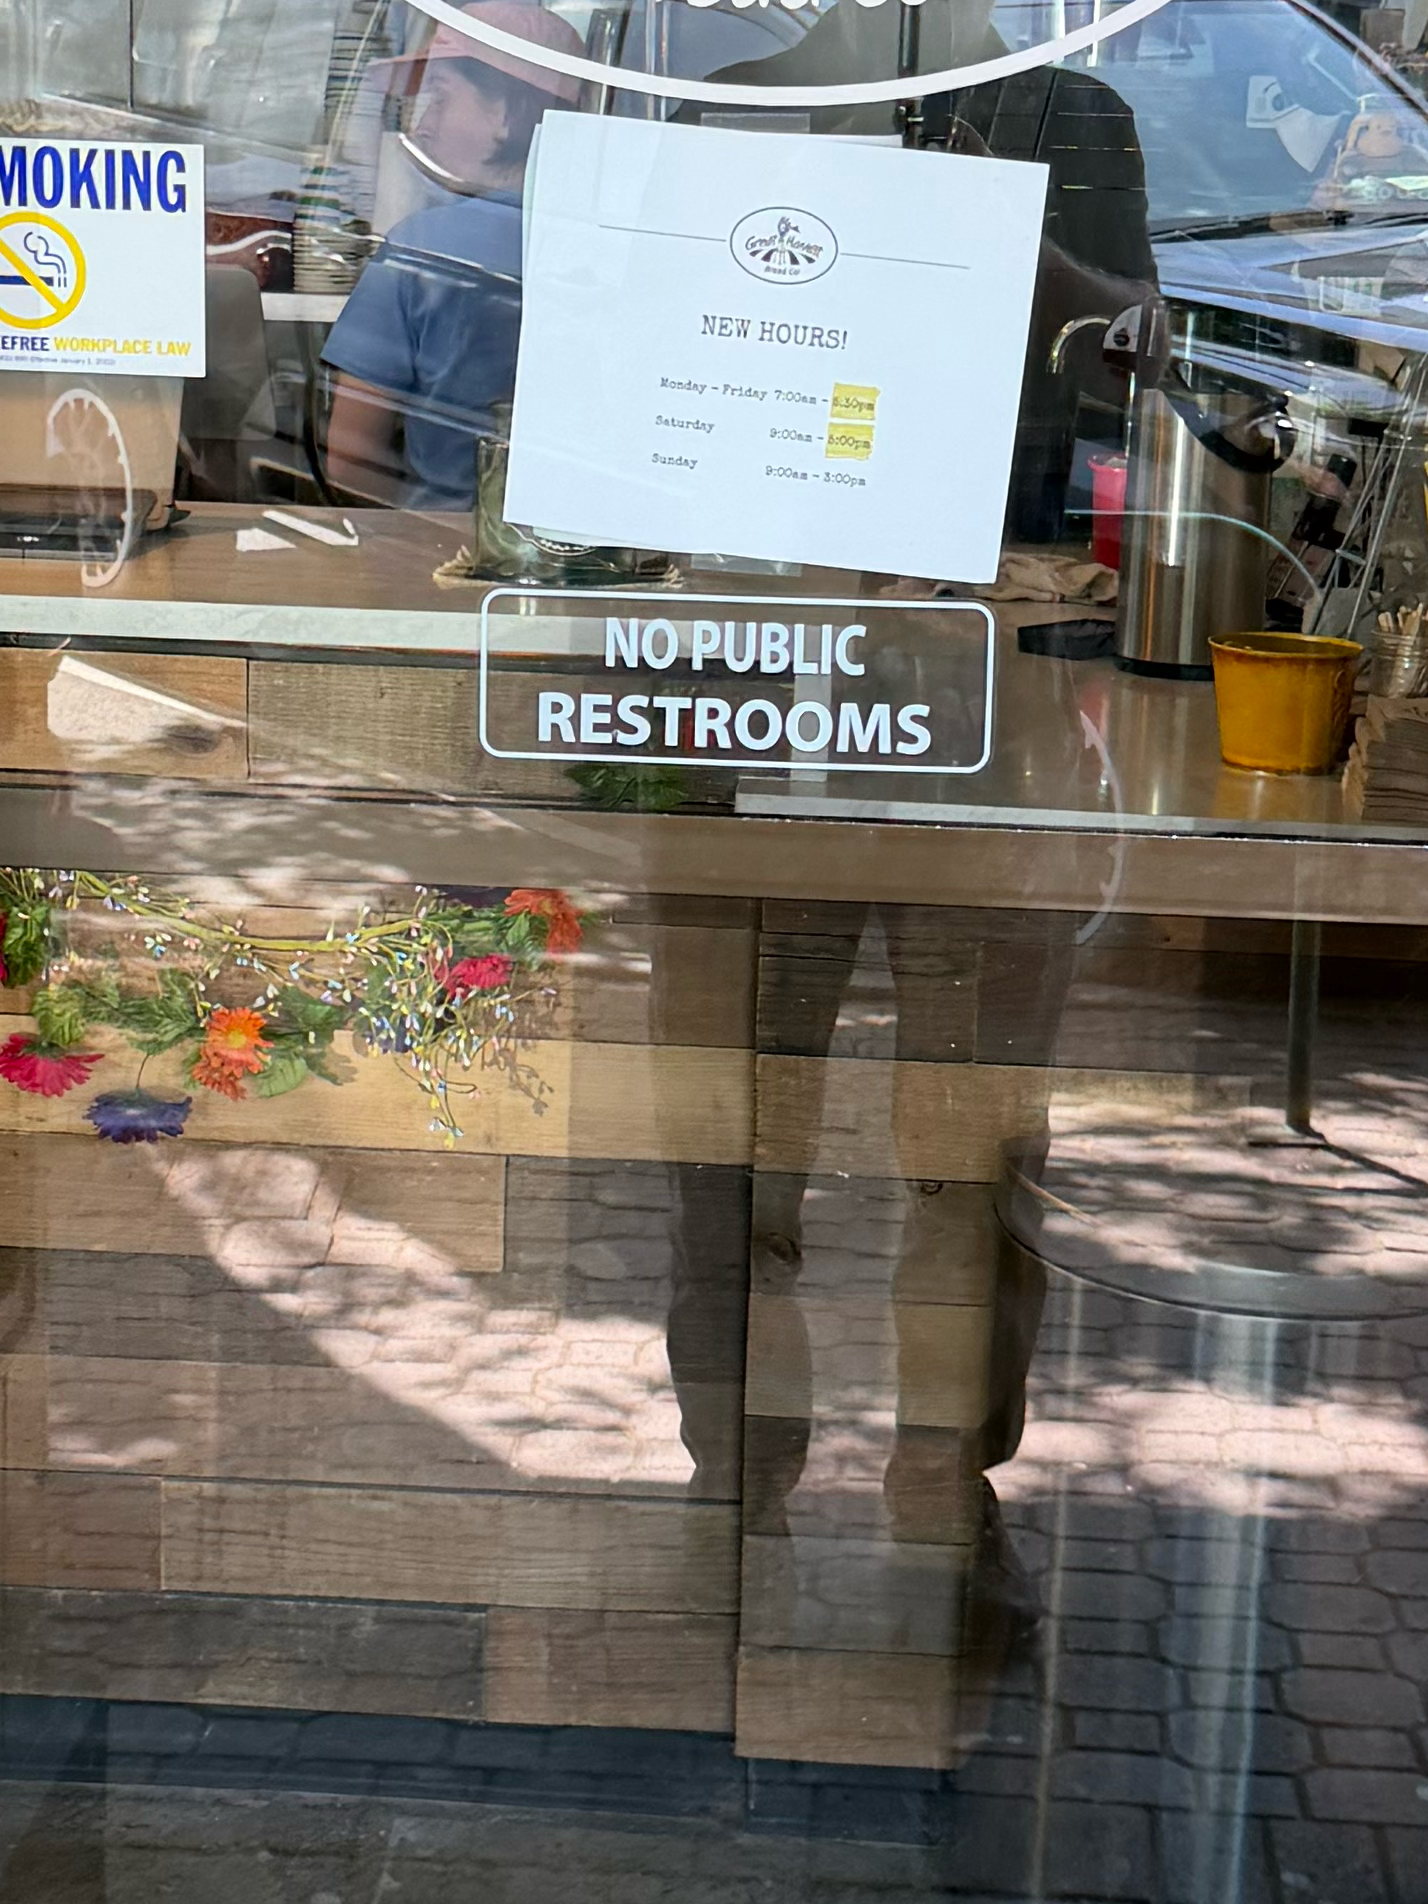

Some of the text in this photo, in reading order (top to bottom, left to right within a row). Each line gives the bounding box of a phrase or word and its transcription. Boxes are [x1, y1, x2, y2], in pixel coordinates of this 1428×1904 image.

[701, 314, 848, 350] NEW HOURS!
[53, 336, 153, 355] WORKPLACE
[157, 340, 192, 357] LAW
[660, 377, 707, 394] Monday
[722, 384, 768, 400] Friday
[774, 389, 817, 405] 7:00am
[655, 415, 715, 434] Saturday
[769, 427, 813, 443] 9:00am
[651, 453, 698, 469] Sunday
[765, 465, 808, 481] 9:00am
[605, 617, 867, 676] NO PUBLIC
[538, 691, 932, 756] RESTROOMS
